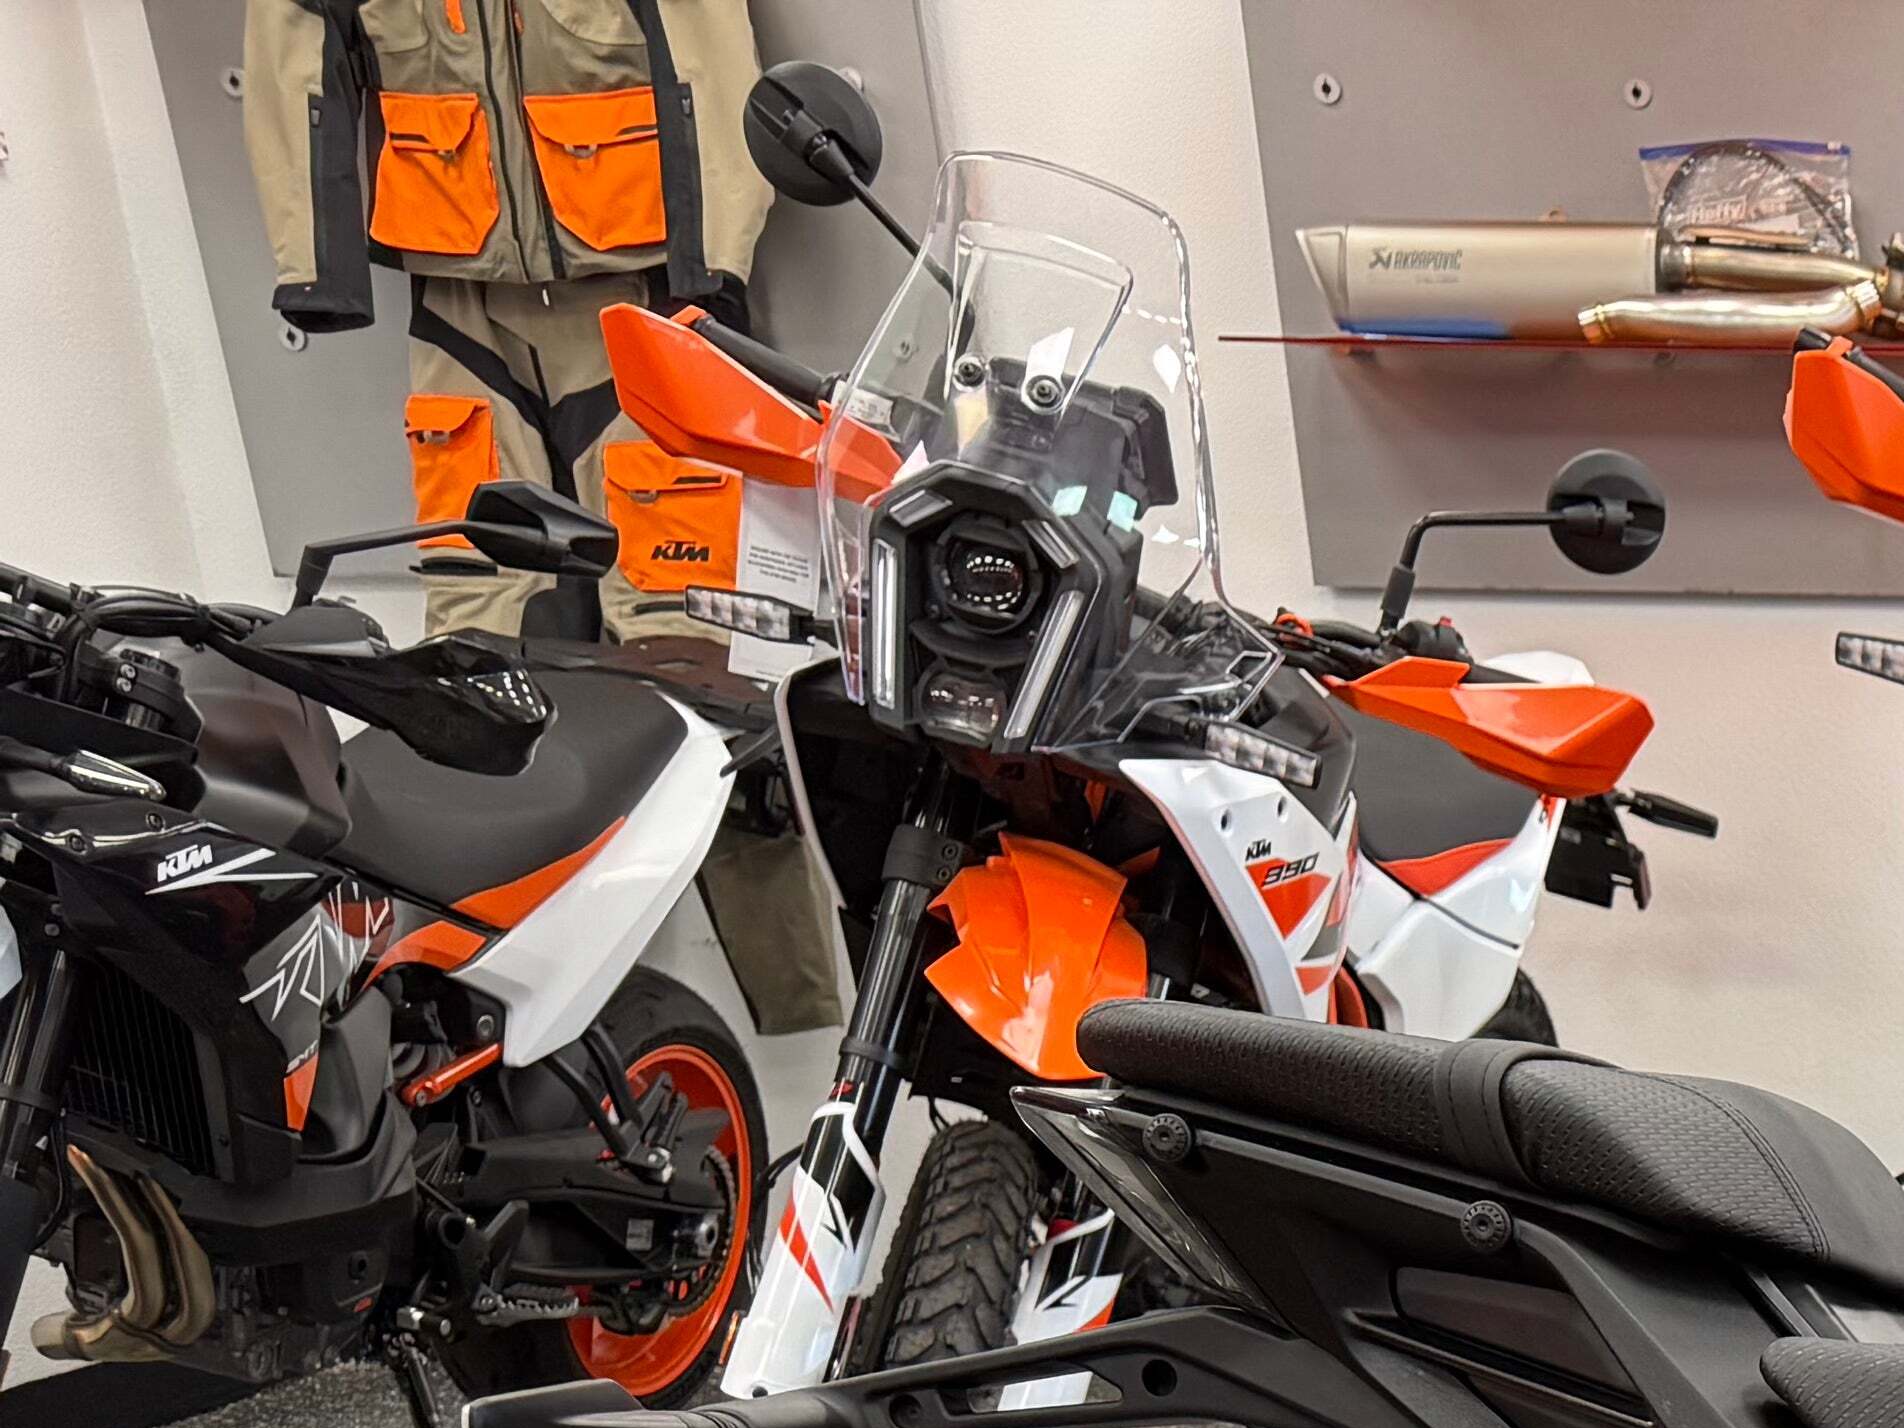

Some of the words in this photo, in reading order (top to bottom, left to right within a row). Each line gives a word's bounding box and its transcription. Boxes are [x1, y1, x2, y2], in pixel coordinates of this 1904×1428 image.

[651, 540, 710, 563] KTM
[1245, 838, 1272, 861] KTM
[158, 844, 212, 882] KTM
